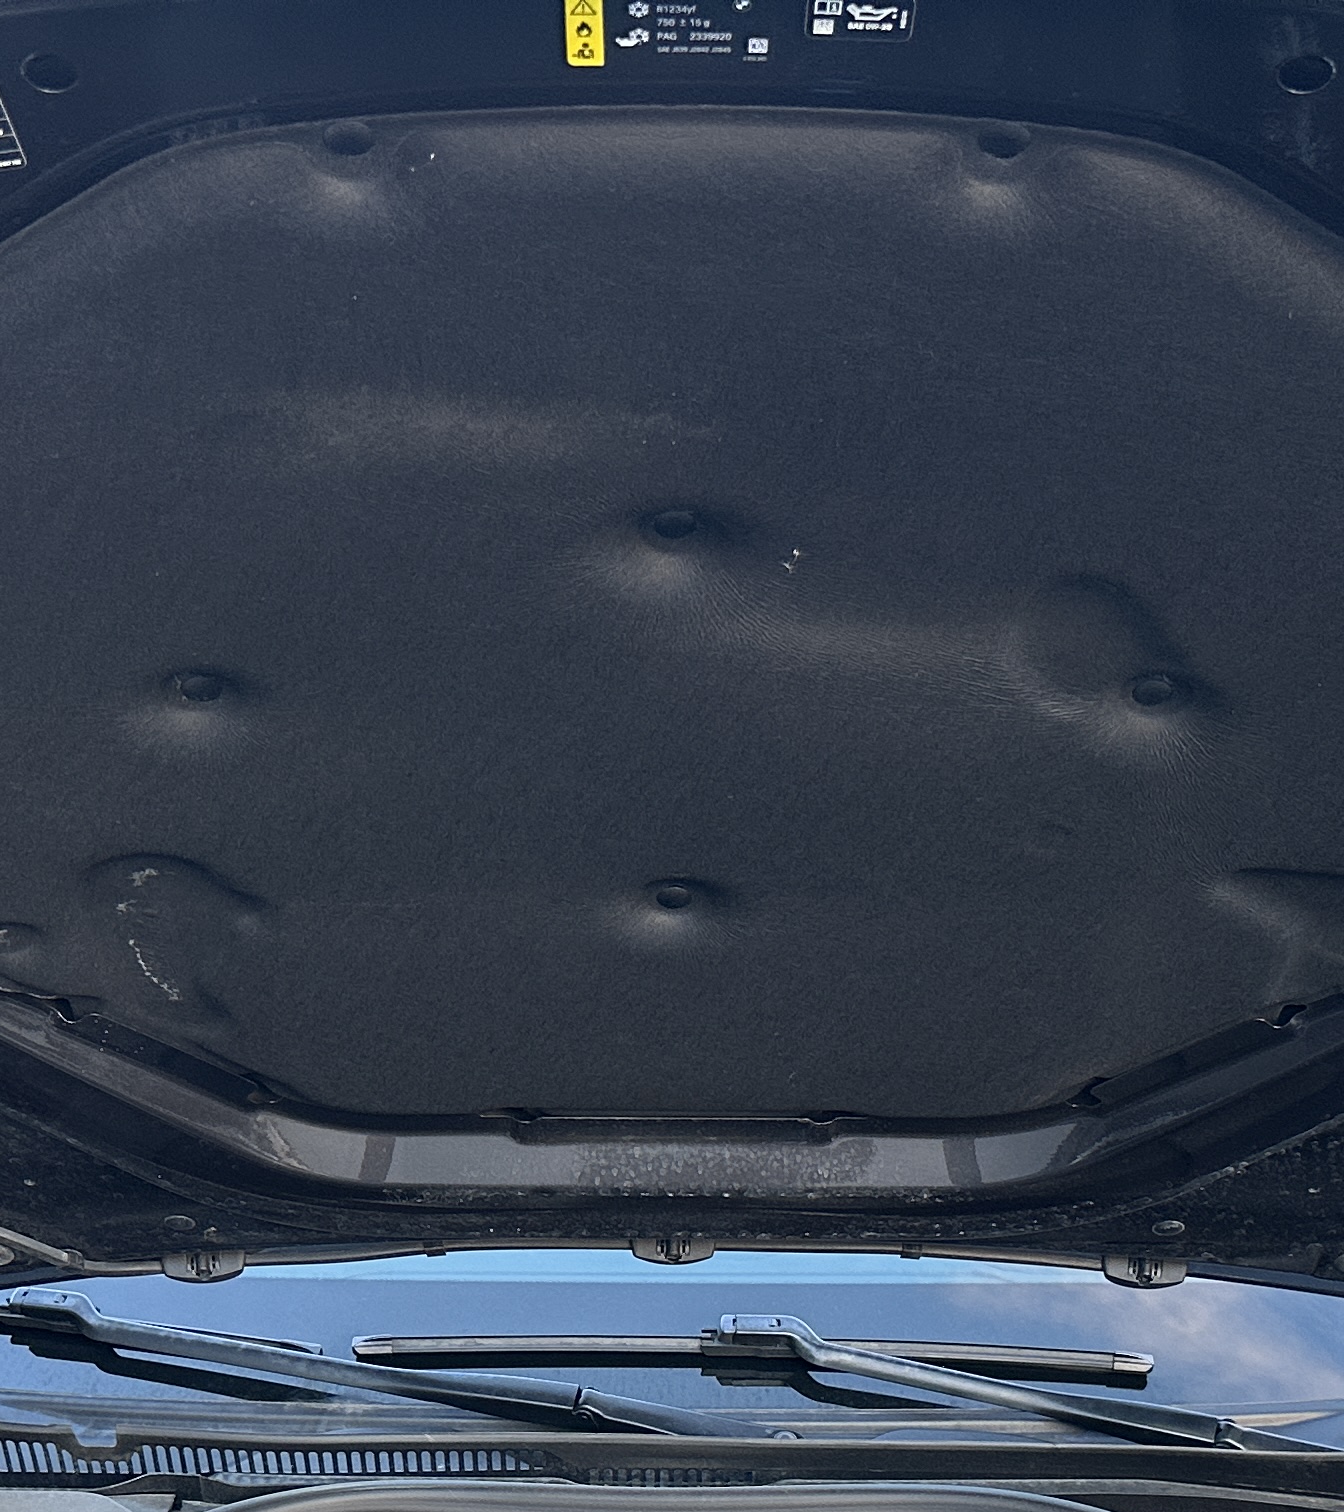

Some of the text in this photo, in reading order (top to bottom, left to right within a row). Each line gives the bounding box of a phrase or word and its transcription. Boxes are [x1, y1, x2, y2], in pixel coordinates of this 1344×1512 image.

[656, 4, 697, 15] R1234yf
[657, 18, 676, 27] 750
[703, 20, 710, 28] g
[657, 32, 677, 41] PAG
